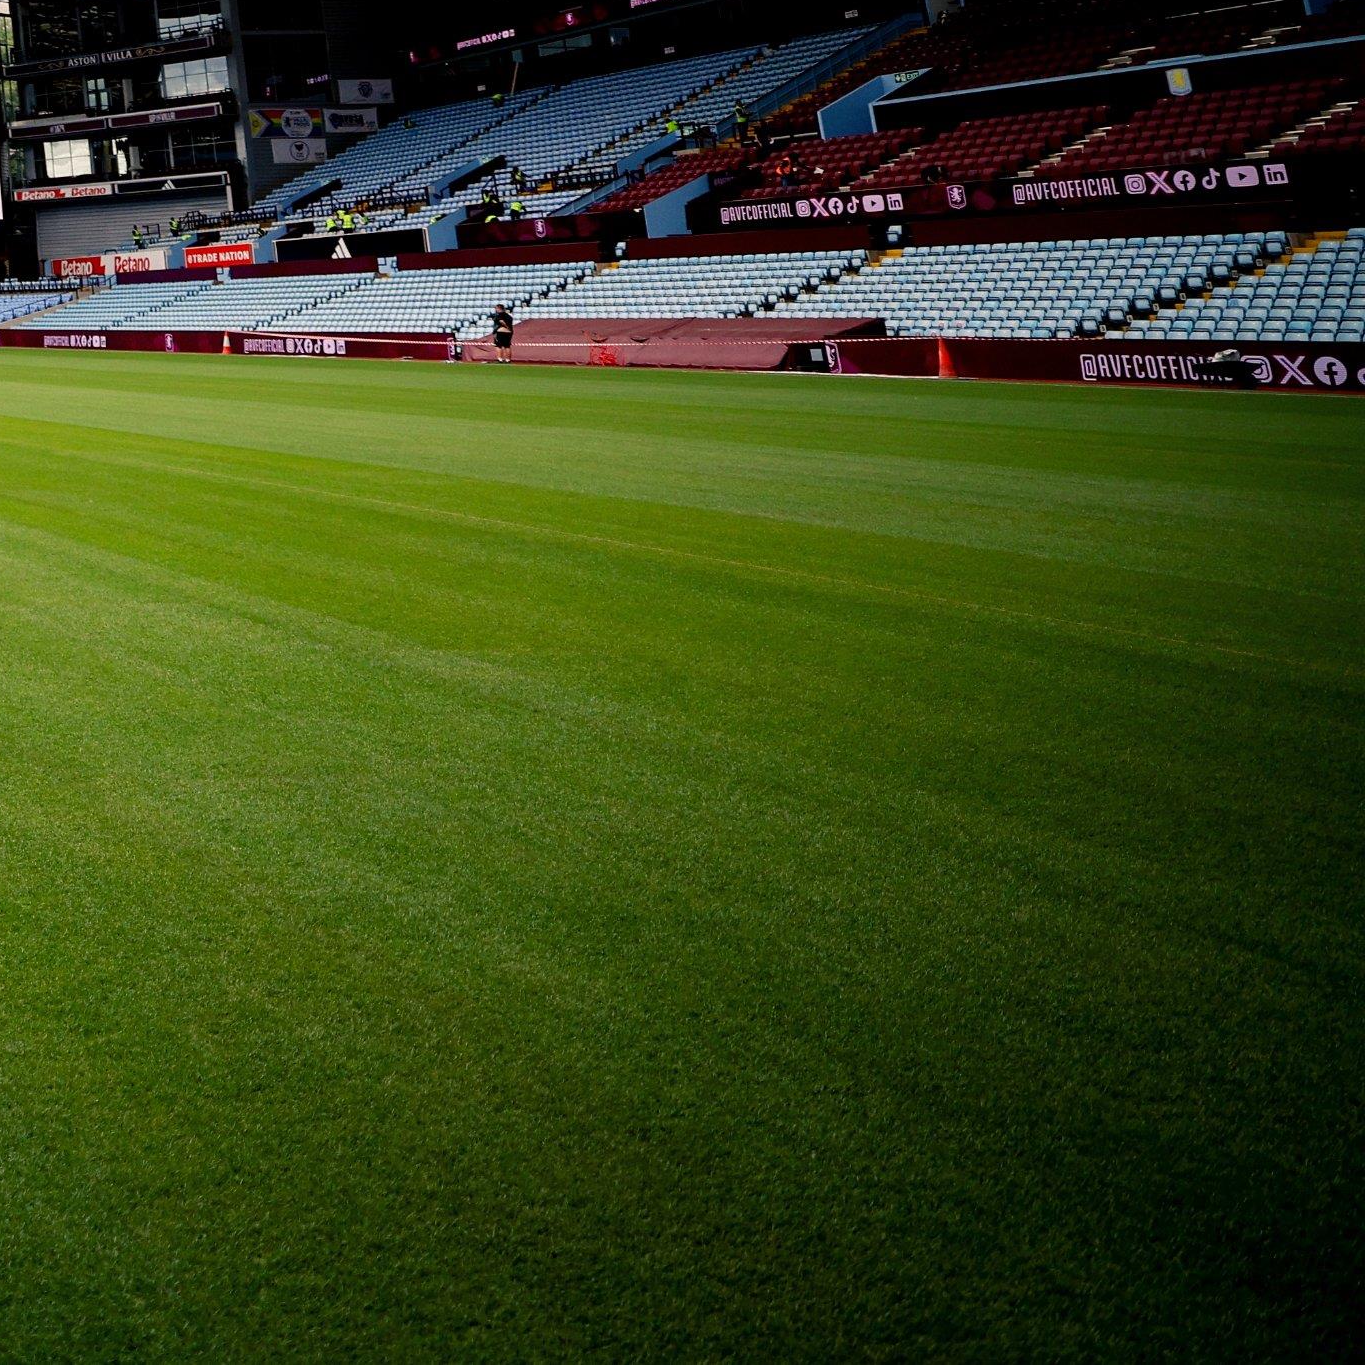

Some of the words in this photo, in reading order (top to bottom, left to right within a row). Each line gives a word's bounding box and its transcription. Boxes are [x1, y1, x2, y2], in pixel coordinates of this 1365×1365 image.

[68, 54, 96, 67] ASTON
[107, 50, 133, 63] VILLA
[22, 189, 56, 200] Betano
[71, 186, 106, 197] Betano
[1012, 177, 1121, 205] @AVFCOFFICIAL
[720, 202, 794, 225] @AVFCOFFICIAL
[192, 252, 219, 263] TRADE
[218, 250, 250, 262] NATION
[60, 260, 94, 276] Betano
[114, 256, 151, 273] Betano
